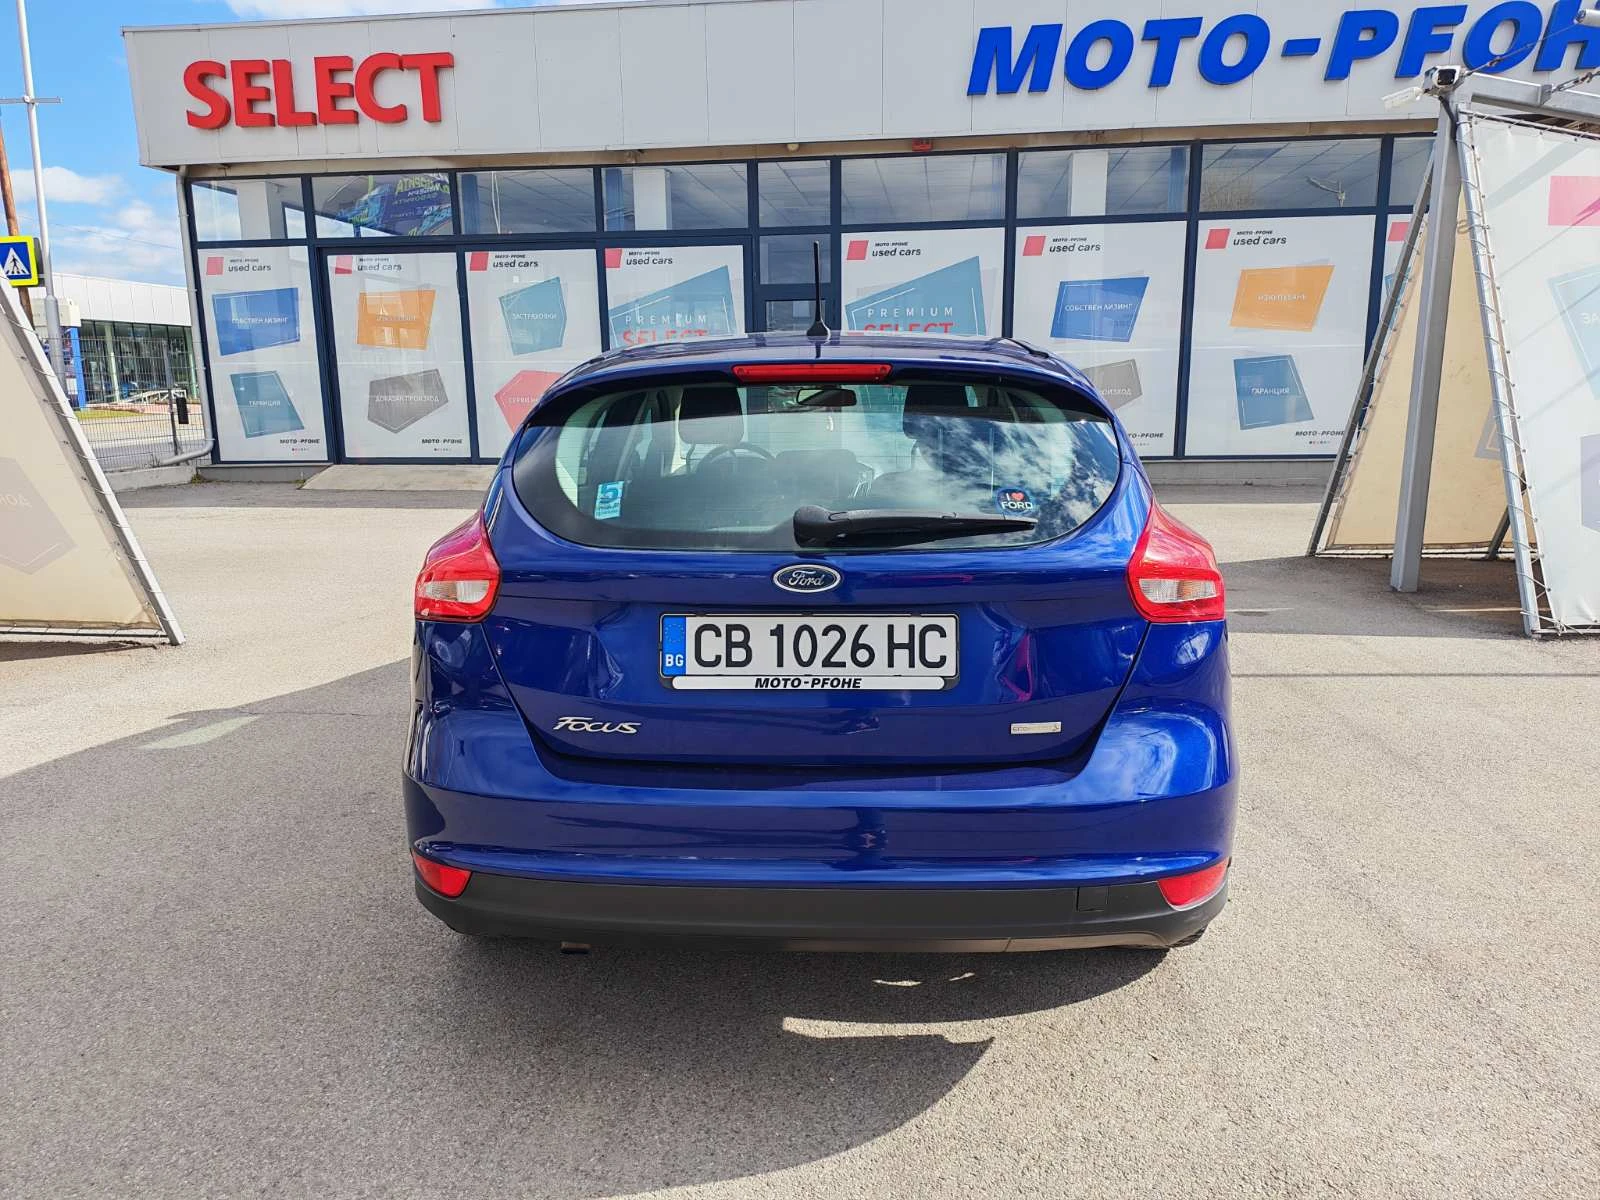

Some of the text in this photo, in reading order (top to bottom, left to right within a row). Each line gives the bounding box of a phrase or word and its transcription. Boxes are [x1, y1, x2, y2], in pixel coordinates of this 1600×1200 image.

[967, 0, 1600, 96] MOTO-PFOH
[183, 52, 454, 129] SELECT
[1233, 236, 1287, 246] used cars
[872, 248, 921, 257] used cars
[1049, 243, 1101, 253] used cars
[493, 259, 539, 268] used cars
[626, 257, 673, 265] used cars
[228, 263, 272, 273] used cars
[357, 262, 402, 271] used cars
[867, 307, 953, 318] PREMIUM
[1001, 501, 1034, 510] FORD
[788, 570, 825, 586] Ford
[694, 623, 947, 669] CB 1026 HC
[665, 654, 684, 667] BG
[754, 677, 862, 689] MOTO-PFOHE
